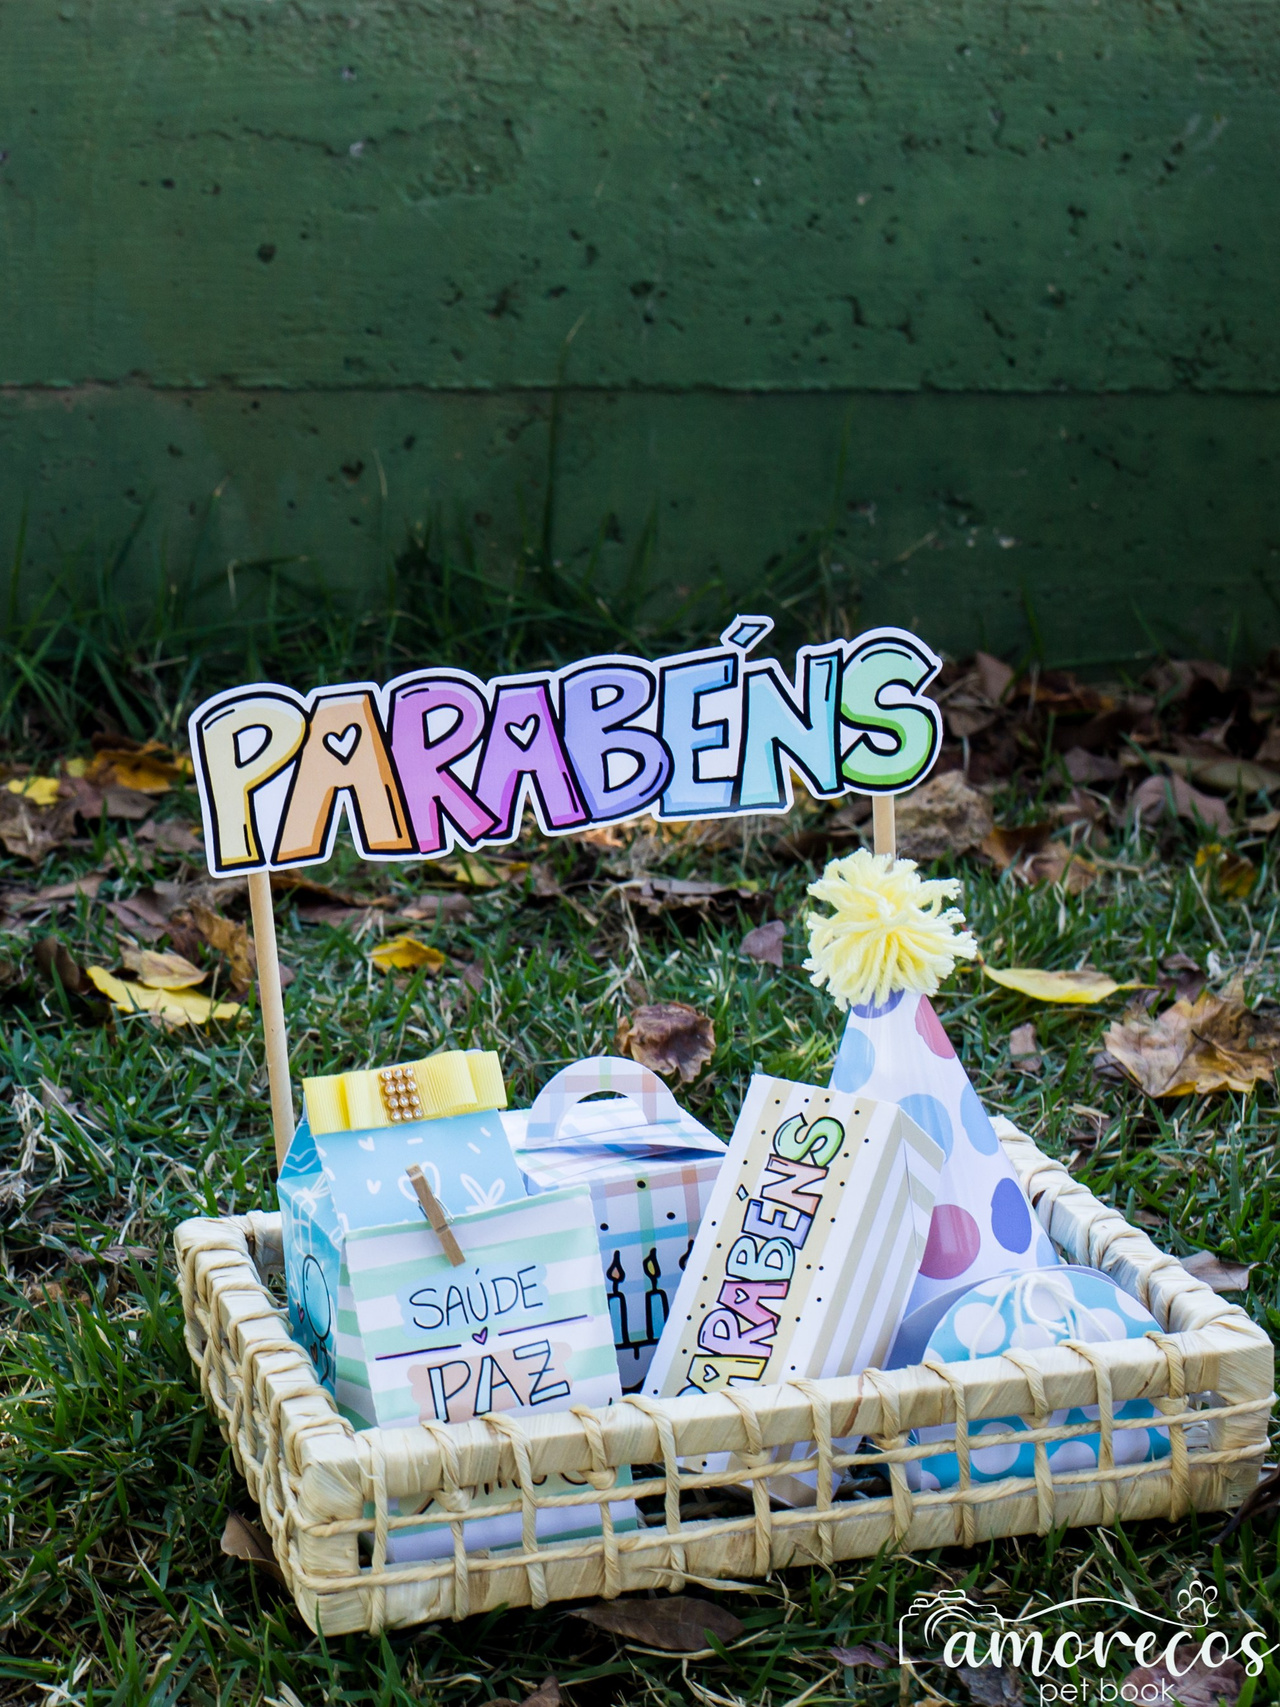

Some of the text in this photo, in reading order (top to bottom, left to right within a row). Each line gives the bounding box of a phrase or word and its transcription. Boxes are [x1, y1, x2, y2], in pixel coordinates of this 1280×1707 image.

[196, 620, 940, 870] PARABÉNS
[409, 1266, 543, 1330] SAÚDE
[677, 1112, 845, 1397] ARABÉNS
[427, 1339, 570, 1423] PAZ
